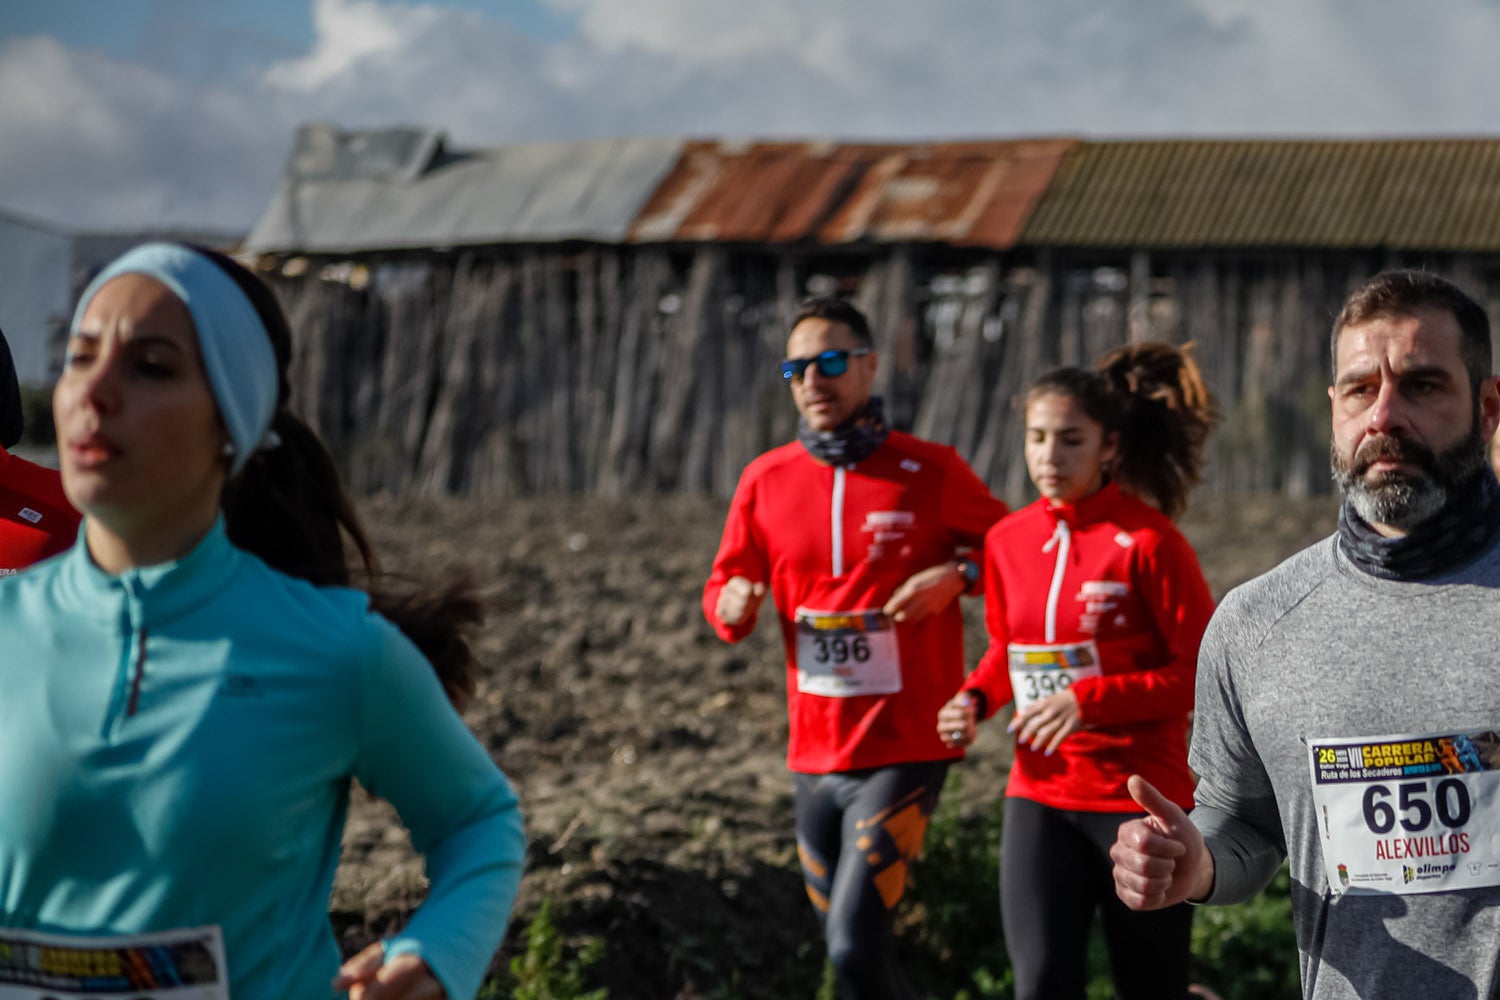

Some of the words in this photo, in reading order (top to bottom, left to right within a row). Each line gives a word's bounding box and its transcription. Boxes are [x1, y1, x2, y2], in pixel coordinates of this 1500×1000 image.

[813, 635, 871, 663] 396
[1319, 748, 1336, 764] 26
[1362, 741, 1434, 758] CARRERA
[1364, 753, 1435, 768] POPULAR
[1321, 770, 1338, 780] Ruta
[1339, 769, 1349, 779] de
[1350, 768, 1361, 778] los
[1362, 766, 1402, 778] Secaderos
[1362, 778, 1471, 834] 650
[1376, 832, 1471, 860] ALEXVILLOS
[1417, 863, 1456, 874] olimpo
